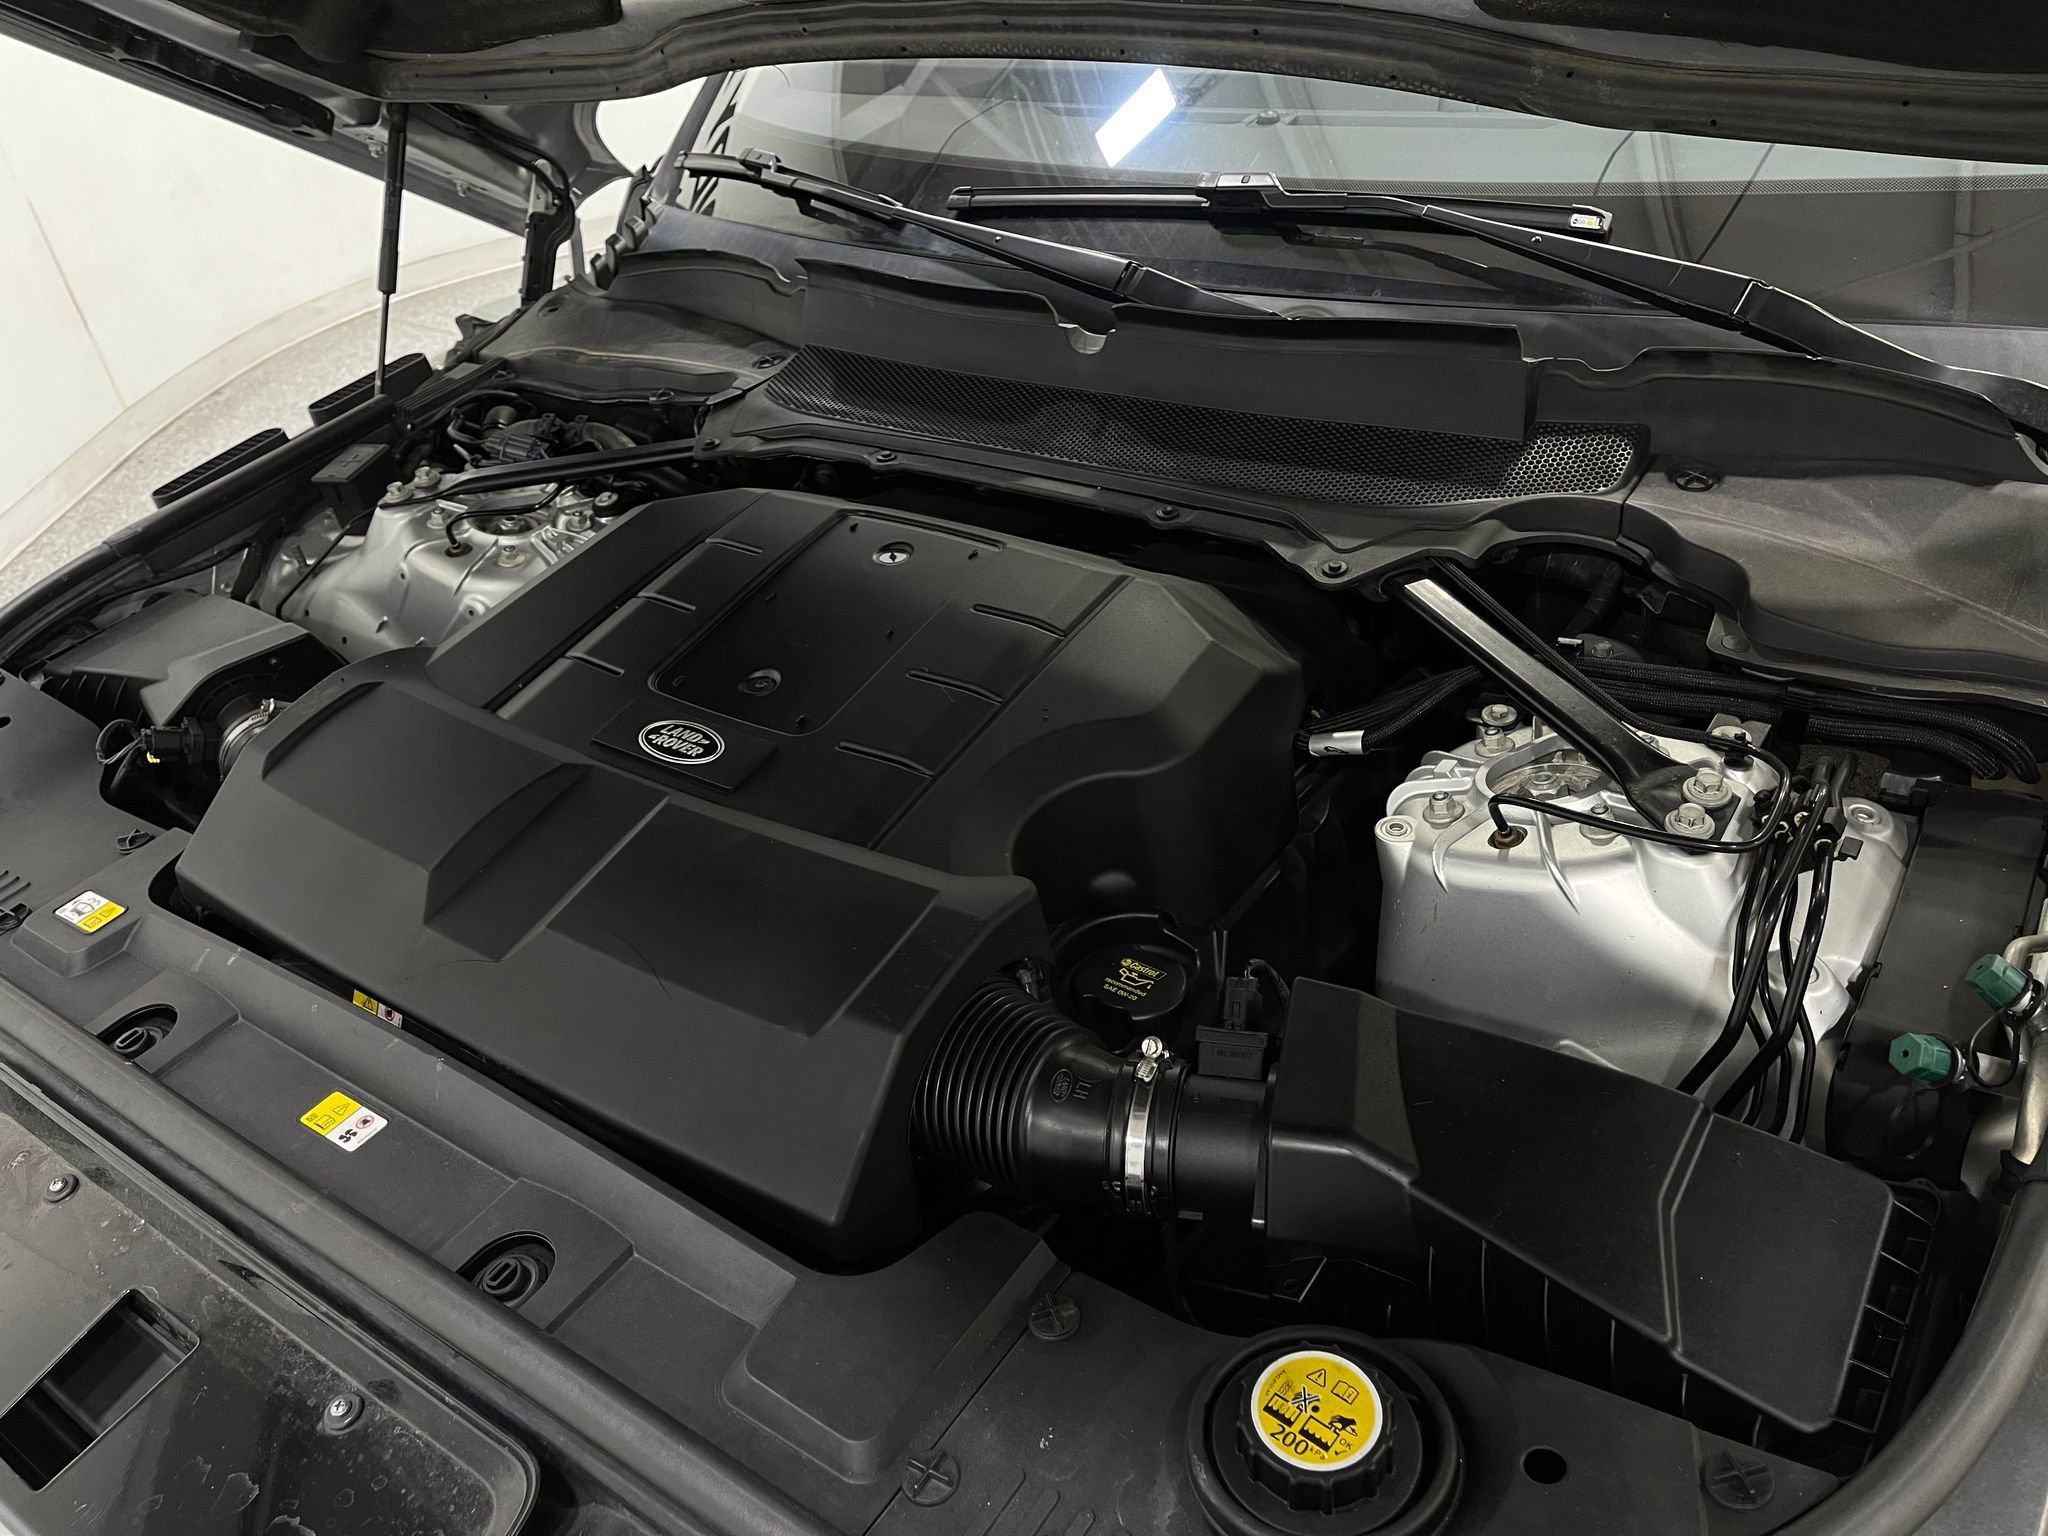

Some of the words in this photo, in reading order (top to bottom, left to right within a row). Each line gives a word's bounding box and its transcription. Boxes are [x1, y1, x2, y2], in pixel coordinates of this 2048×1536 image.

[659, 724, 704, 743] LAND
[651, 734, 704, 757] ROVER
[1129, 962, 1160, 978] Castrol
[1104, 977, 1147, 997] recommended
[1269, 1423, 1309, 1455] 200
[1338, 1437, 1353, 1451] OK
